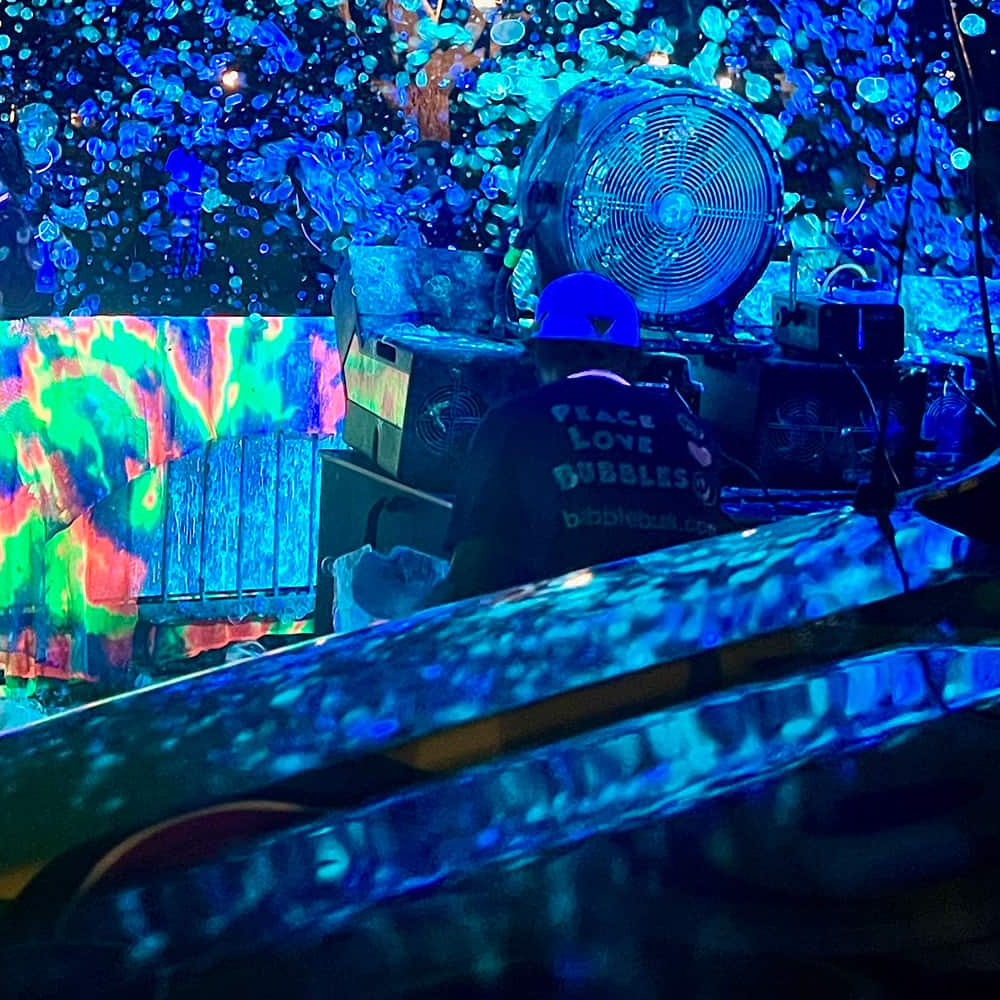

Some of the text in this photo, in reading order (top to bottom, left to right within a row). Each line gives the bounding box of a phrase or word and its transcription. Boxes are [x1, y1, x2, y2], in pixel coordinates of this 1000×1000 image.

[551, 403, 656, 429] PEACE
[568, 425, 653, 453] LOVE
[552, 461, 689, 490] BUBBLES
